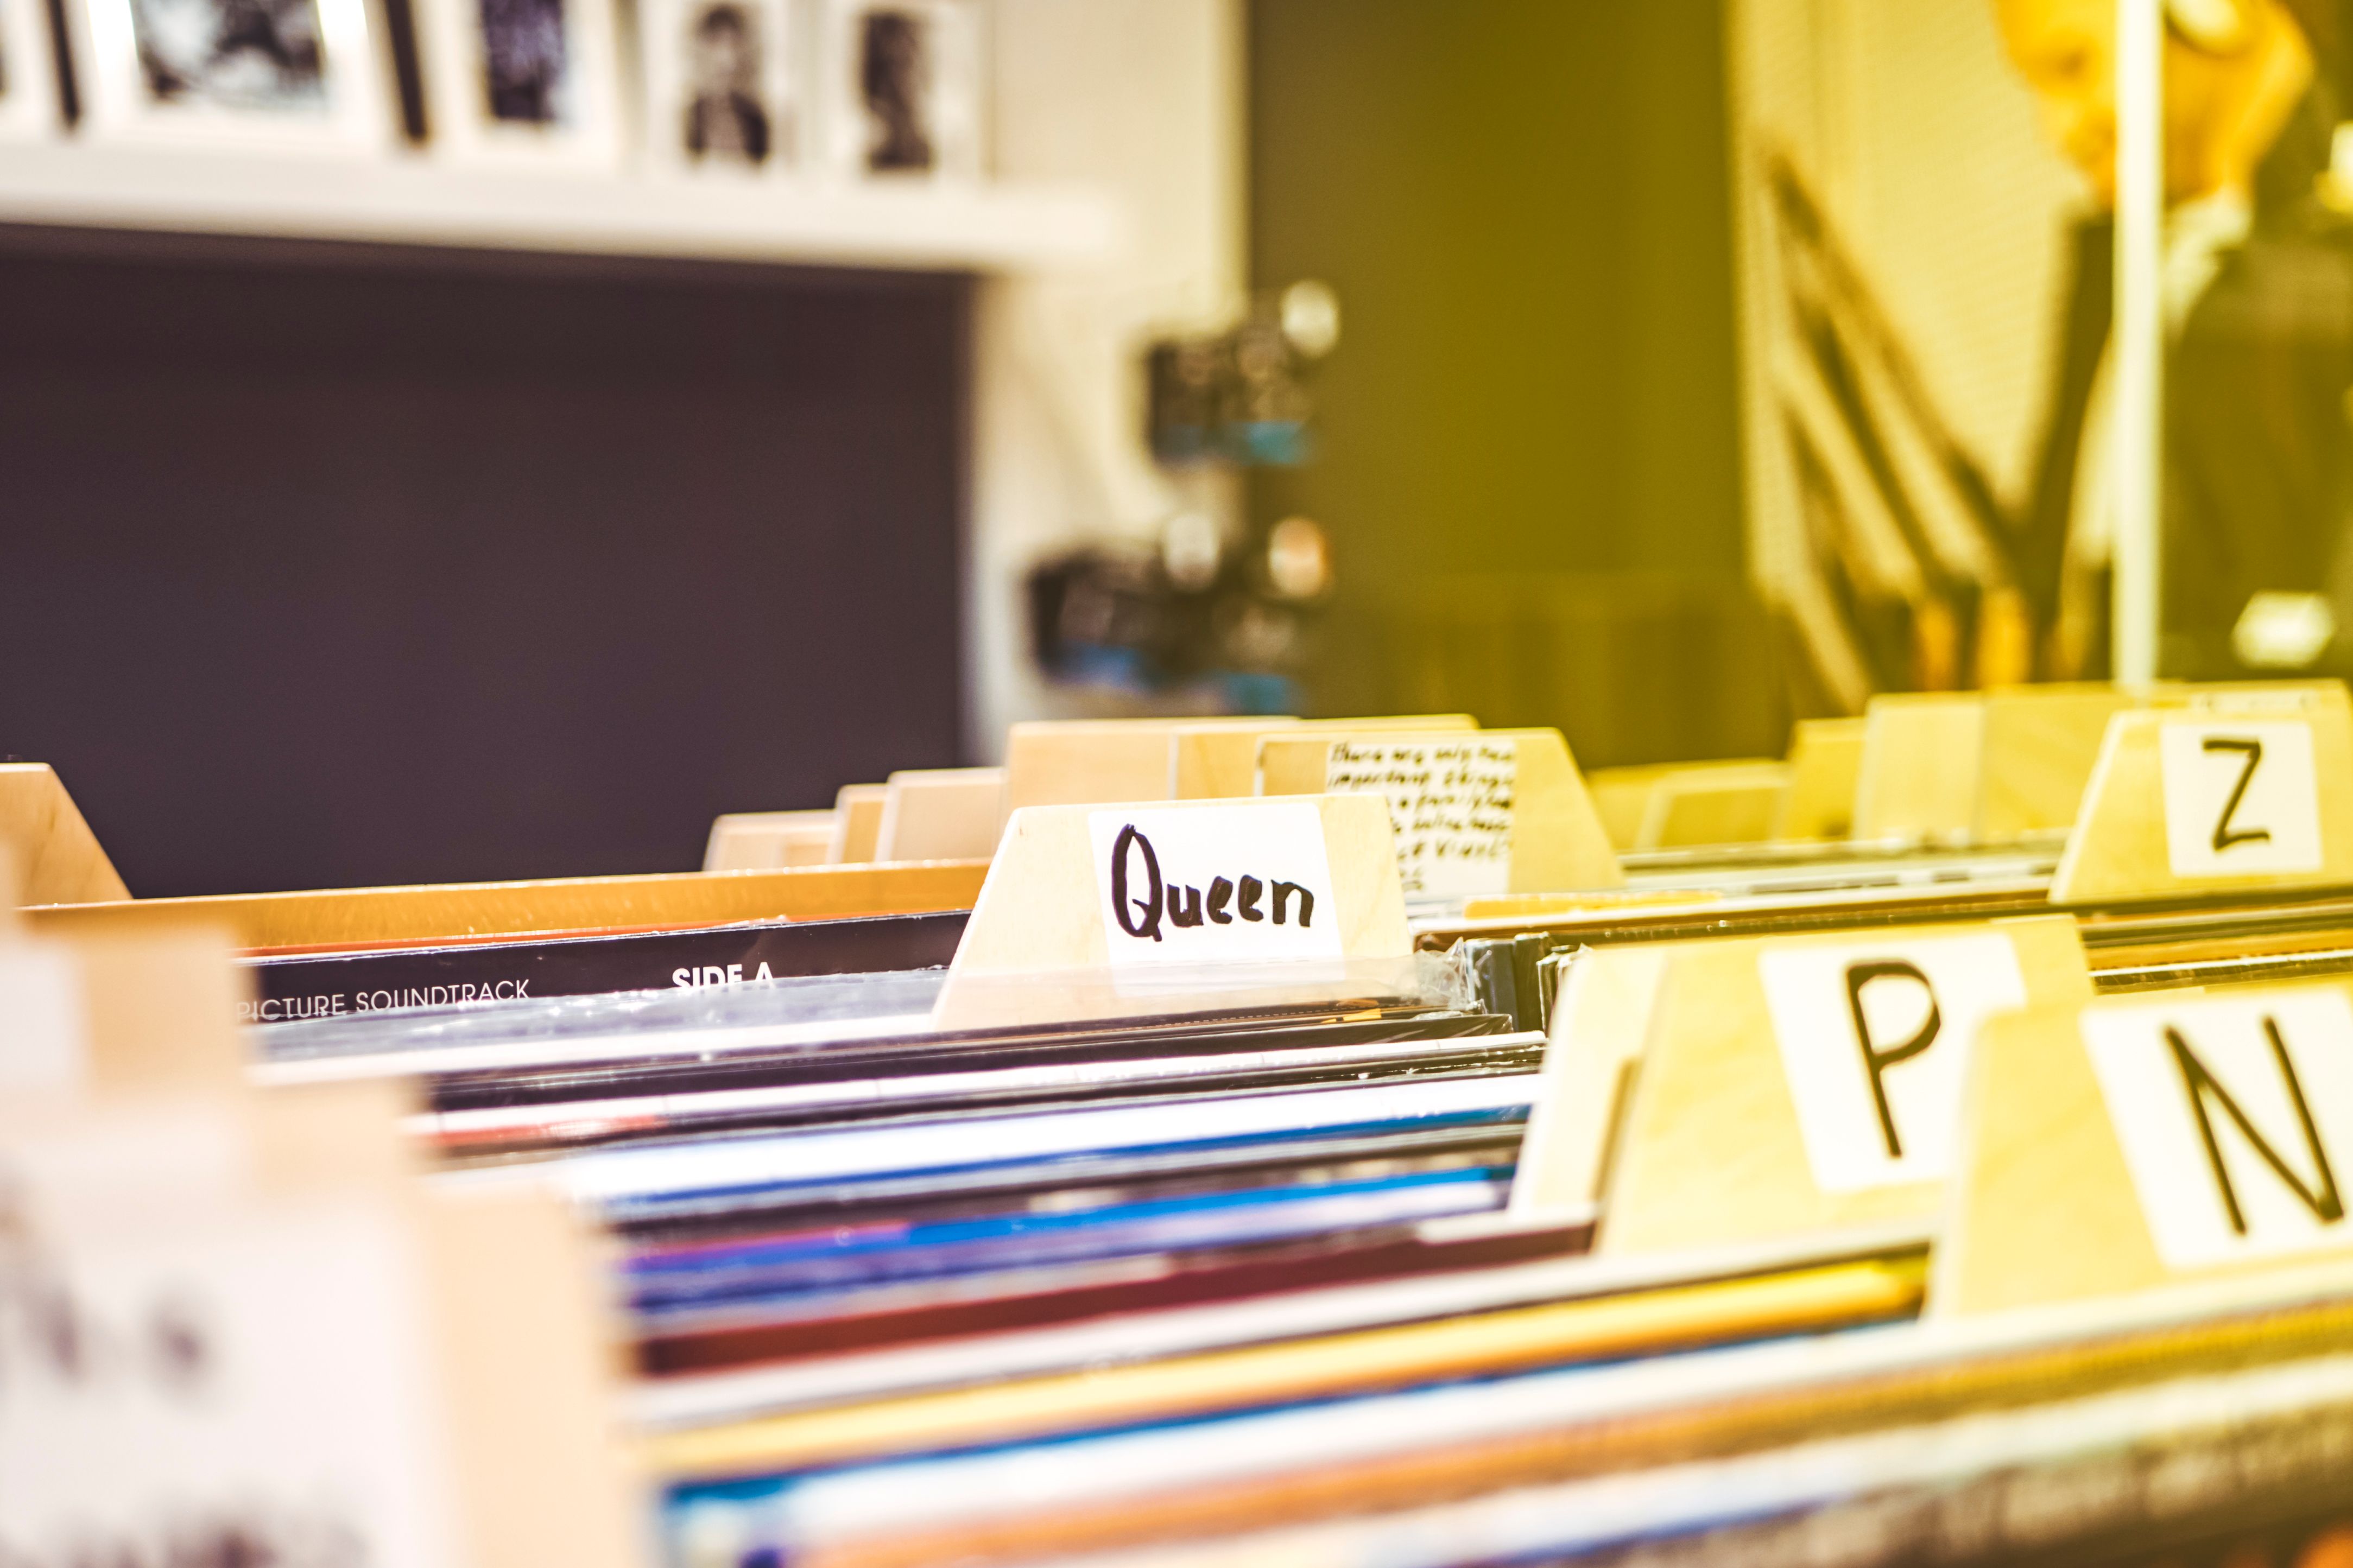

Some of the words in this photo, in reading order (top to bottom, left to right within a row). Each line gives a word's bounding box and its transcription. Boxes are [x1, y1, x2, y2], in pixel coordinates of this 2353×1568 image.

[2203, 739, 2270, 850] Z
[1111, 823, 1314, 942] Queen
[238, 993, 345, 1023] PICTURE
[356, 979, 529, 1013] SOUNDTRACK
[755, 961, 774, 982] A
[1847, 962, 1941, 1157] P
[2166, 1018, 2344, 1235] N
